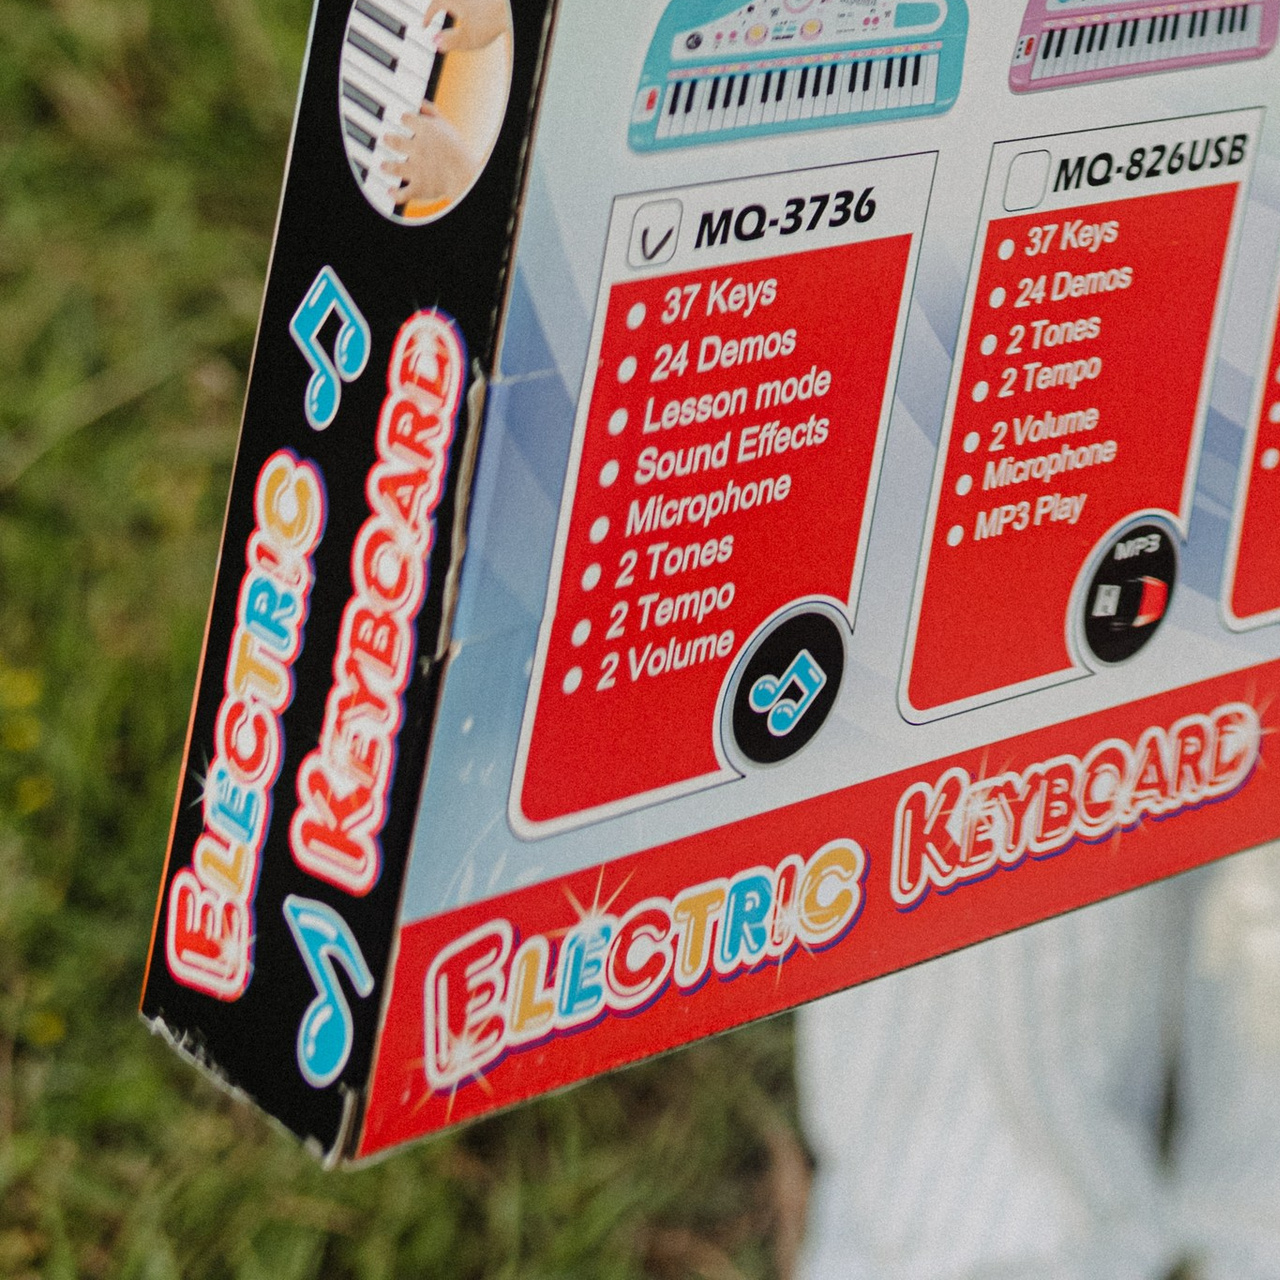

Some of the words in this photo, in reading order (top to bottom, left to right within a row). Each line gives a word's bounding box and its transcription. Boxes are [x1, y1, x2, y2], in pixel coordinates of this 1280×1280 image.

[1053, 133, 1248, 192] MQ-826USB
[694, 186, 877, 250] MQ-3736
[1024, 224, 1058, 257] 37
[1059, 219, 1120, 253] Keys
[660, 283, 701, 325] 37
[706, 277, 778, 318] Keys
[1013, 274, 1047, 308] 24
[1050, 266, 1134, 301] Demos
[649, 340, 690, 383] 24
[697, 328, 798, 373] Demos
[1005, 324, 1026, 355] 2
[1030, 316, 1102, 350] Tones
[642, 387, 749, 435] Lesson
[754, 365, 833, 411] mode
[997, 367, 1018, 398] 2
[1022, 356, 1103, 392] Tempo
[633, 432, 732, 486] Sound
[737, 413, 830, 463] Effects
[988, 421, 1008, 452] 2
[1012, 407, 1100, 447] Volume
[982, 439, 1118, 491] Microphone
[624, 473, 792, 538] Microphone
[973, 500, 1030, 541] MP3
[1033, 493, 1088, 526] Play
[614, 549, 638, 590] 2
[646, 534, 734, 580] Tones
[1114, 533, 1161, 561] MP3
[290, 308, 466, 898] KEYBOARD
[605, 600, 629, 641] 2
[637, 582, 735, 631] Tempo
[595, 651, 620, 692] 2
[628, 629, 735, 682] Volume
[167, 449, 326, 1002] ELECTRIC
[424, 837, 868, 1090] ELECTRIC
[890, 702, 1262, 907] KEYBOARD
